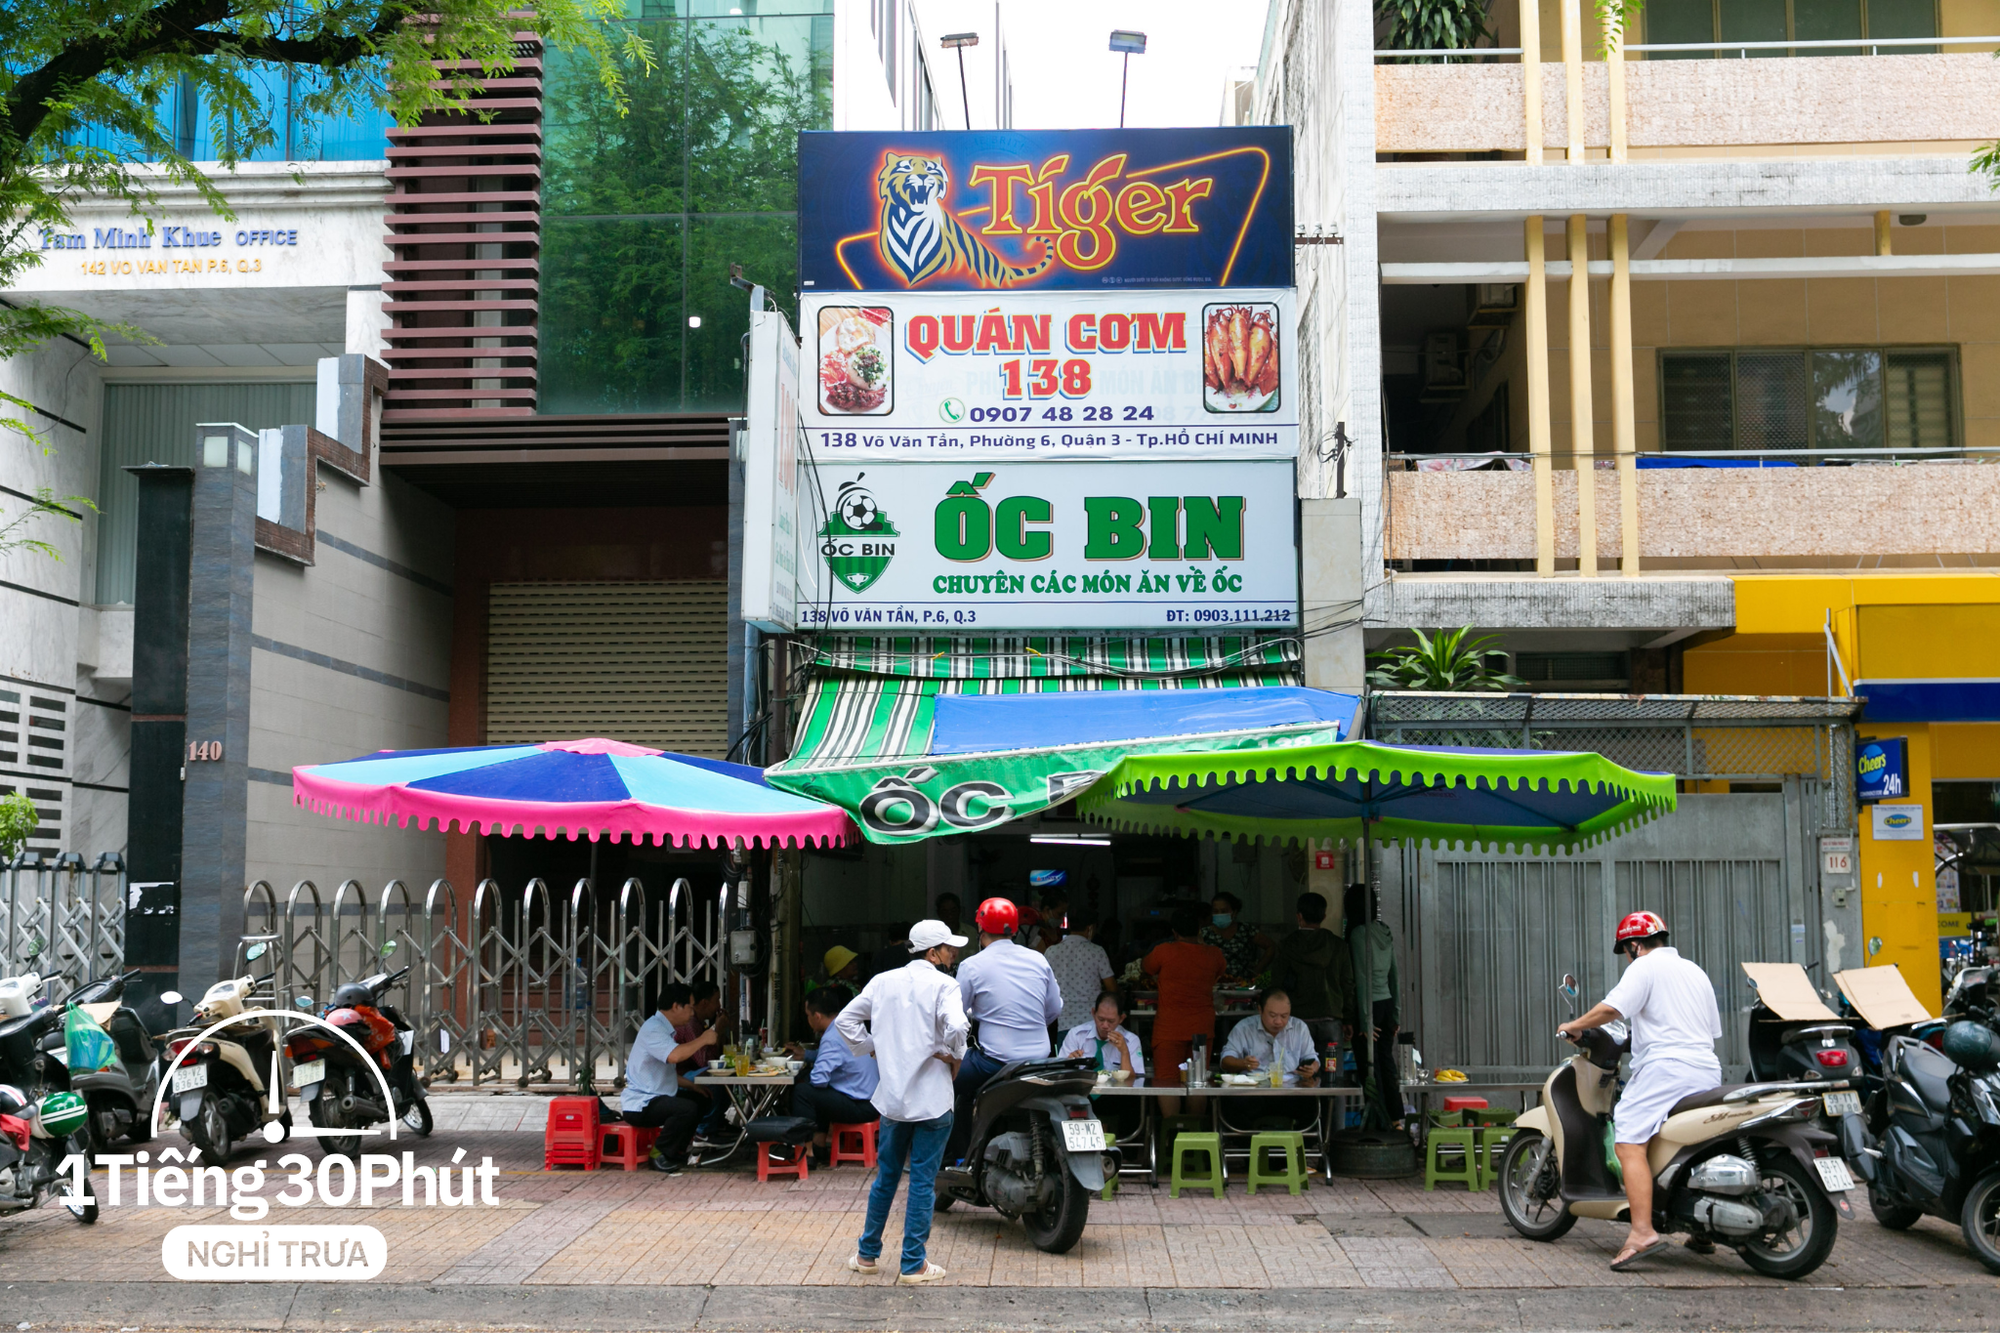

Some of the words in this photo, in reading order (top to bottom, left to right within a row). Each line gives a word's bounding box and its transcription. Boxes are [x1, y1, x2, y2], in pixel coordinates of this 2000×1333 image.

[969, 153, 1213, 271] Tiger
[38, 229, 86, 249] Tam
[94, 228, 151, 248] Minh
[162, 226, 221, 247] Khue
[235, 230, 298, 246] OFFICE
[81, 261, 105, 275] 142
[110, 260, 132, 274] VO
[137, 260, 167, 273] VAN
[173, 259, 202, 272] TAN
[207, 259, 232, 274] P.6,
[237, 258, 262, 272] Q.3
[904, 307, 1051, 364] QUÁN
[1064, 312, 1187, 354] CƠM
[999, 359, 1092, 400] 138
[970, 406, 1032, 423] 0907
[1042, 406, 1073, 422] 48
[1083, 406, 1113, 421] 28
[1123, 406, 1154, 421] 24
[821, 433, 857, 448] 138
[863, 434, 885, 448] Võ
[890, 435, 922, 448] Văn
[927, 432, 964, 449] Tần,
[970, 434, 1036, 450] Phường
[1041, 435, 1055, 448] 6,
[1061, 434, 1106, 449] Quận
[1111, 434, 1121, 446] 3
[1137, 428, 1190, 449] Tp.HỒ
[1195, 430, 1224, 446] CHÍ
[1230, 432, 1278, 445] MINH
[934, 472, 1054, 563] ỐC
[1084, 496, 1246, 561] BIN
[820, 538, 854, 556] ỐC
[862, 543, 895, 556] BIN
[933, 570, 1025, 594] CHUYÊN
[1030, 569, 1077, 594] CÁC
[1081, 569, 1131, 594] MÓN
[1136, 569, 1170, 593] ĂN
[1175, 566, 1207, 593] VỀ
[1212, 566, 1242, 593] ỐC
[801, 610, 827, 623] 138
[832, 607, 850, 623] VÕ
[854, 607, 882, 623] VĂN
[886, 605, 918, 624] TẦN,
[923, 610, 949, 624] P.6,
[953, 610, 976, 624] Q.3
[1166, 609, 1190, 622] ĐT:
[1193, 609, 1291, 622] 0903.111.212
[188, 740, 223, 761] 140
[1858, 753, 1886, 774] Cheers
[1883, 773, 1902, 796] 24h
[859, 765, 1015, 836] ỐC
[1883, 815, 1911, 826] Cheers
[1829, 856, 1847, 868] 116
[178, 1067, 201, 1080] 59-V2
[1068, 1123, 1097, 1135] 59-M2
